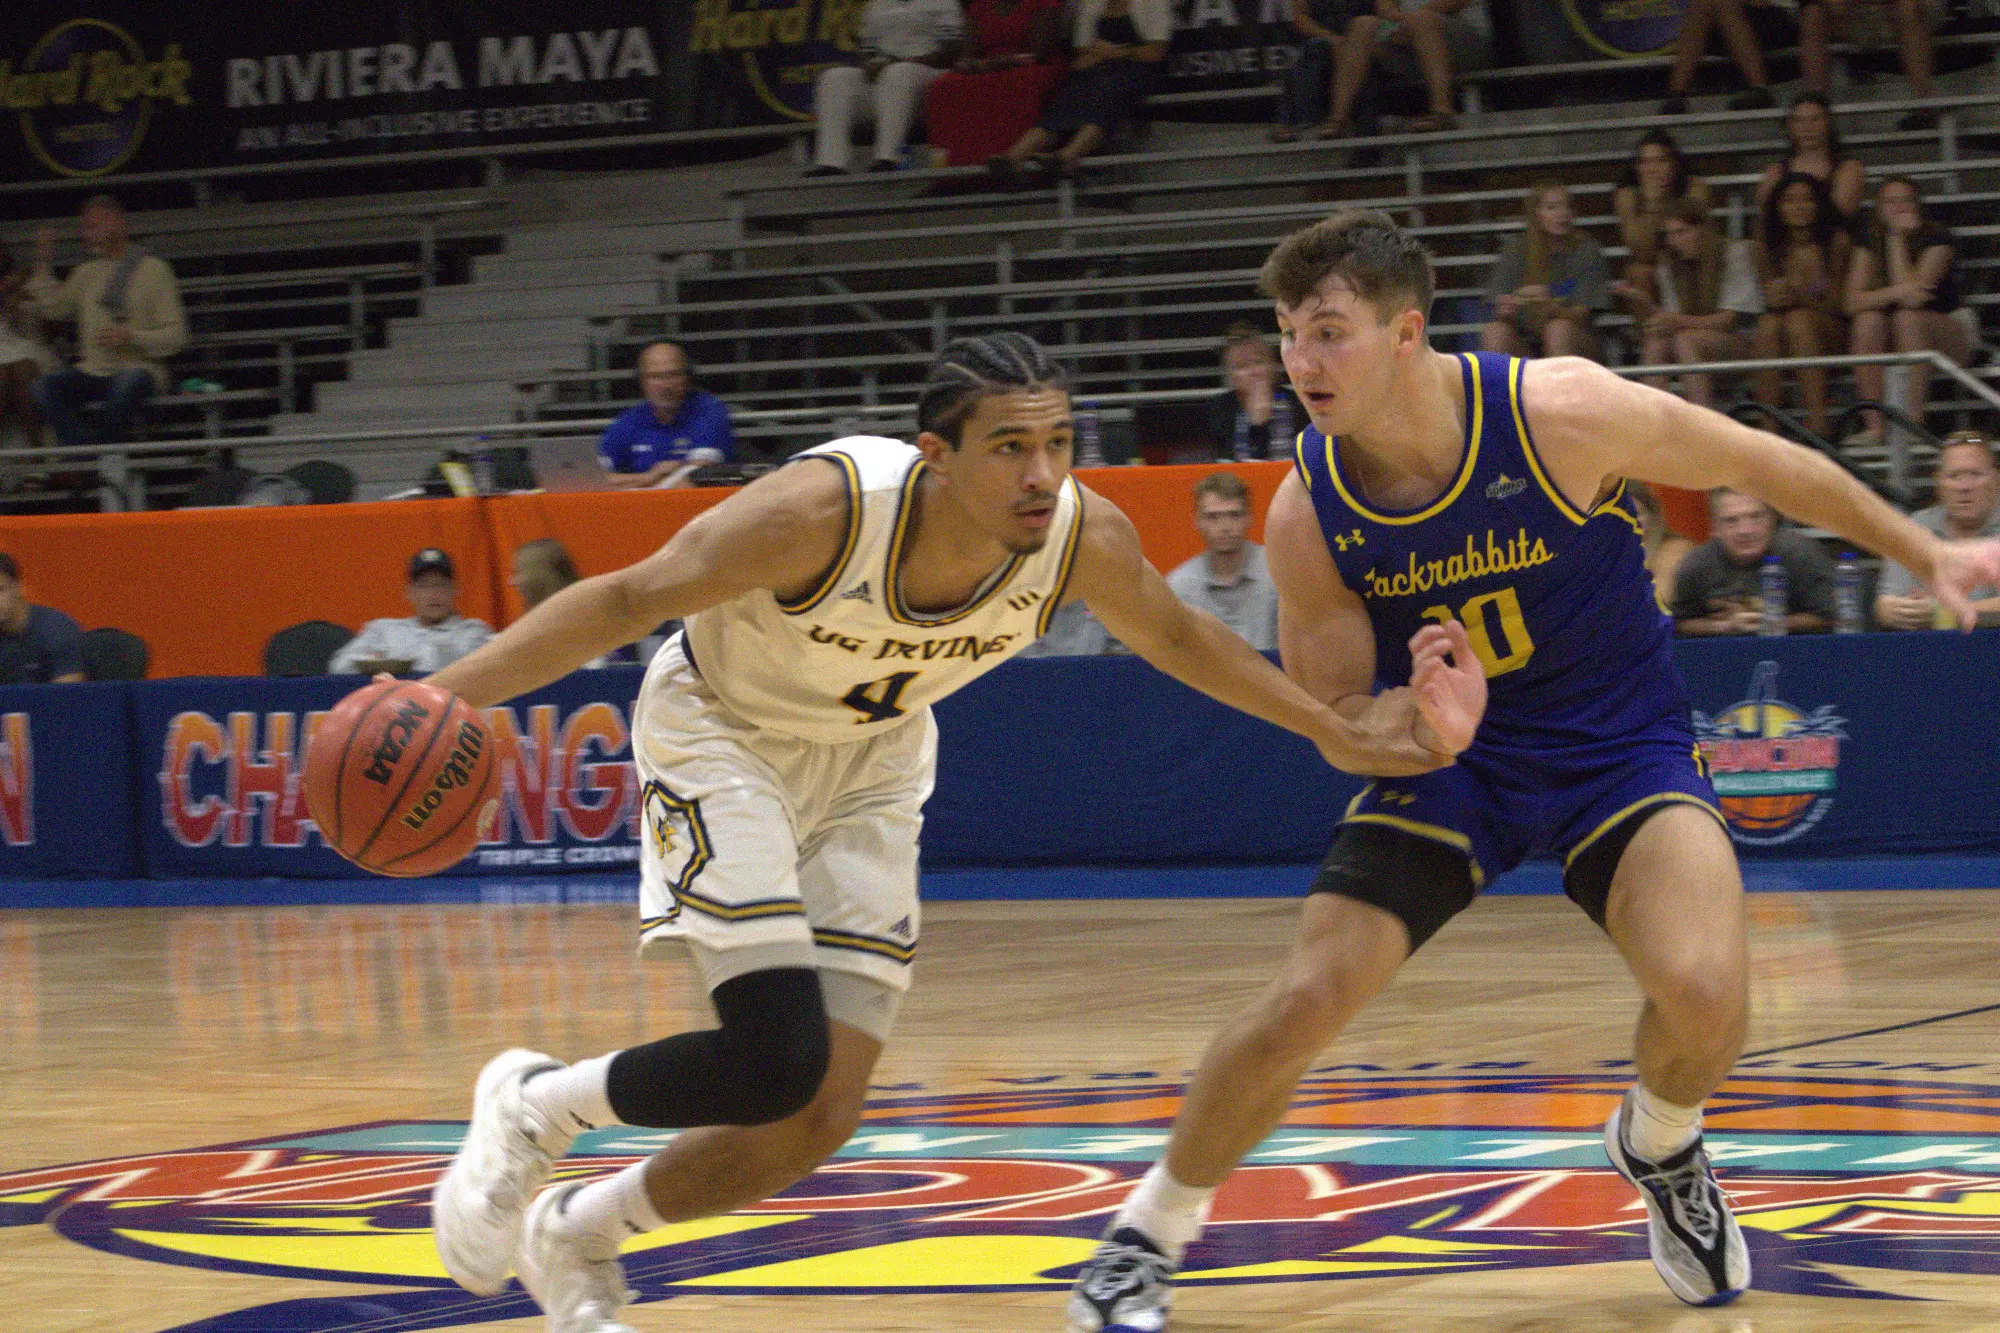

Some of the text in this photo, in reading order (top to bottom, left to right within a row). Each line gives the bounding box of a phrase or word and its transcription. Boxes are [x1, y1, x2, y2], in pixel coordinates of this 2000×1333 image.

[226, 27, 661, 108] RIVIERA MAYA
[872, 633, 1016, 663] IRVINE
[1419, 586, 1536, 679] 0
[839, 669, 925, 726] 4
[361, 699, 429, 786] NCAA
[402, 720, 483, 832] Wilson
